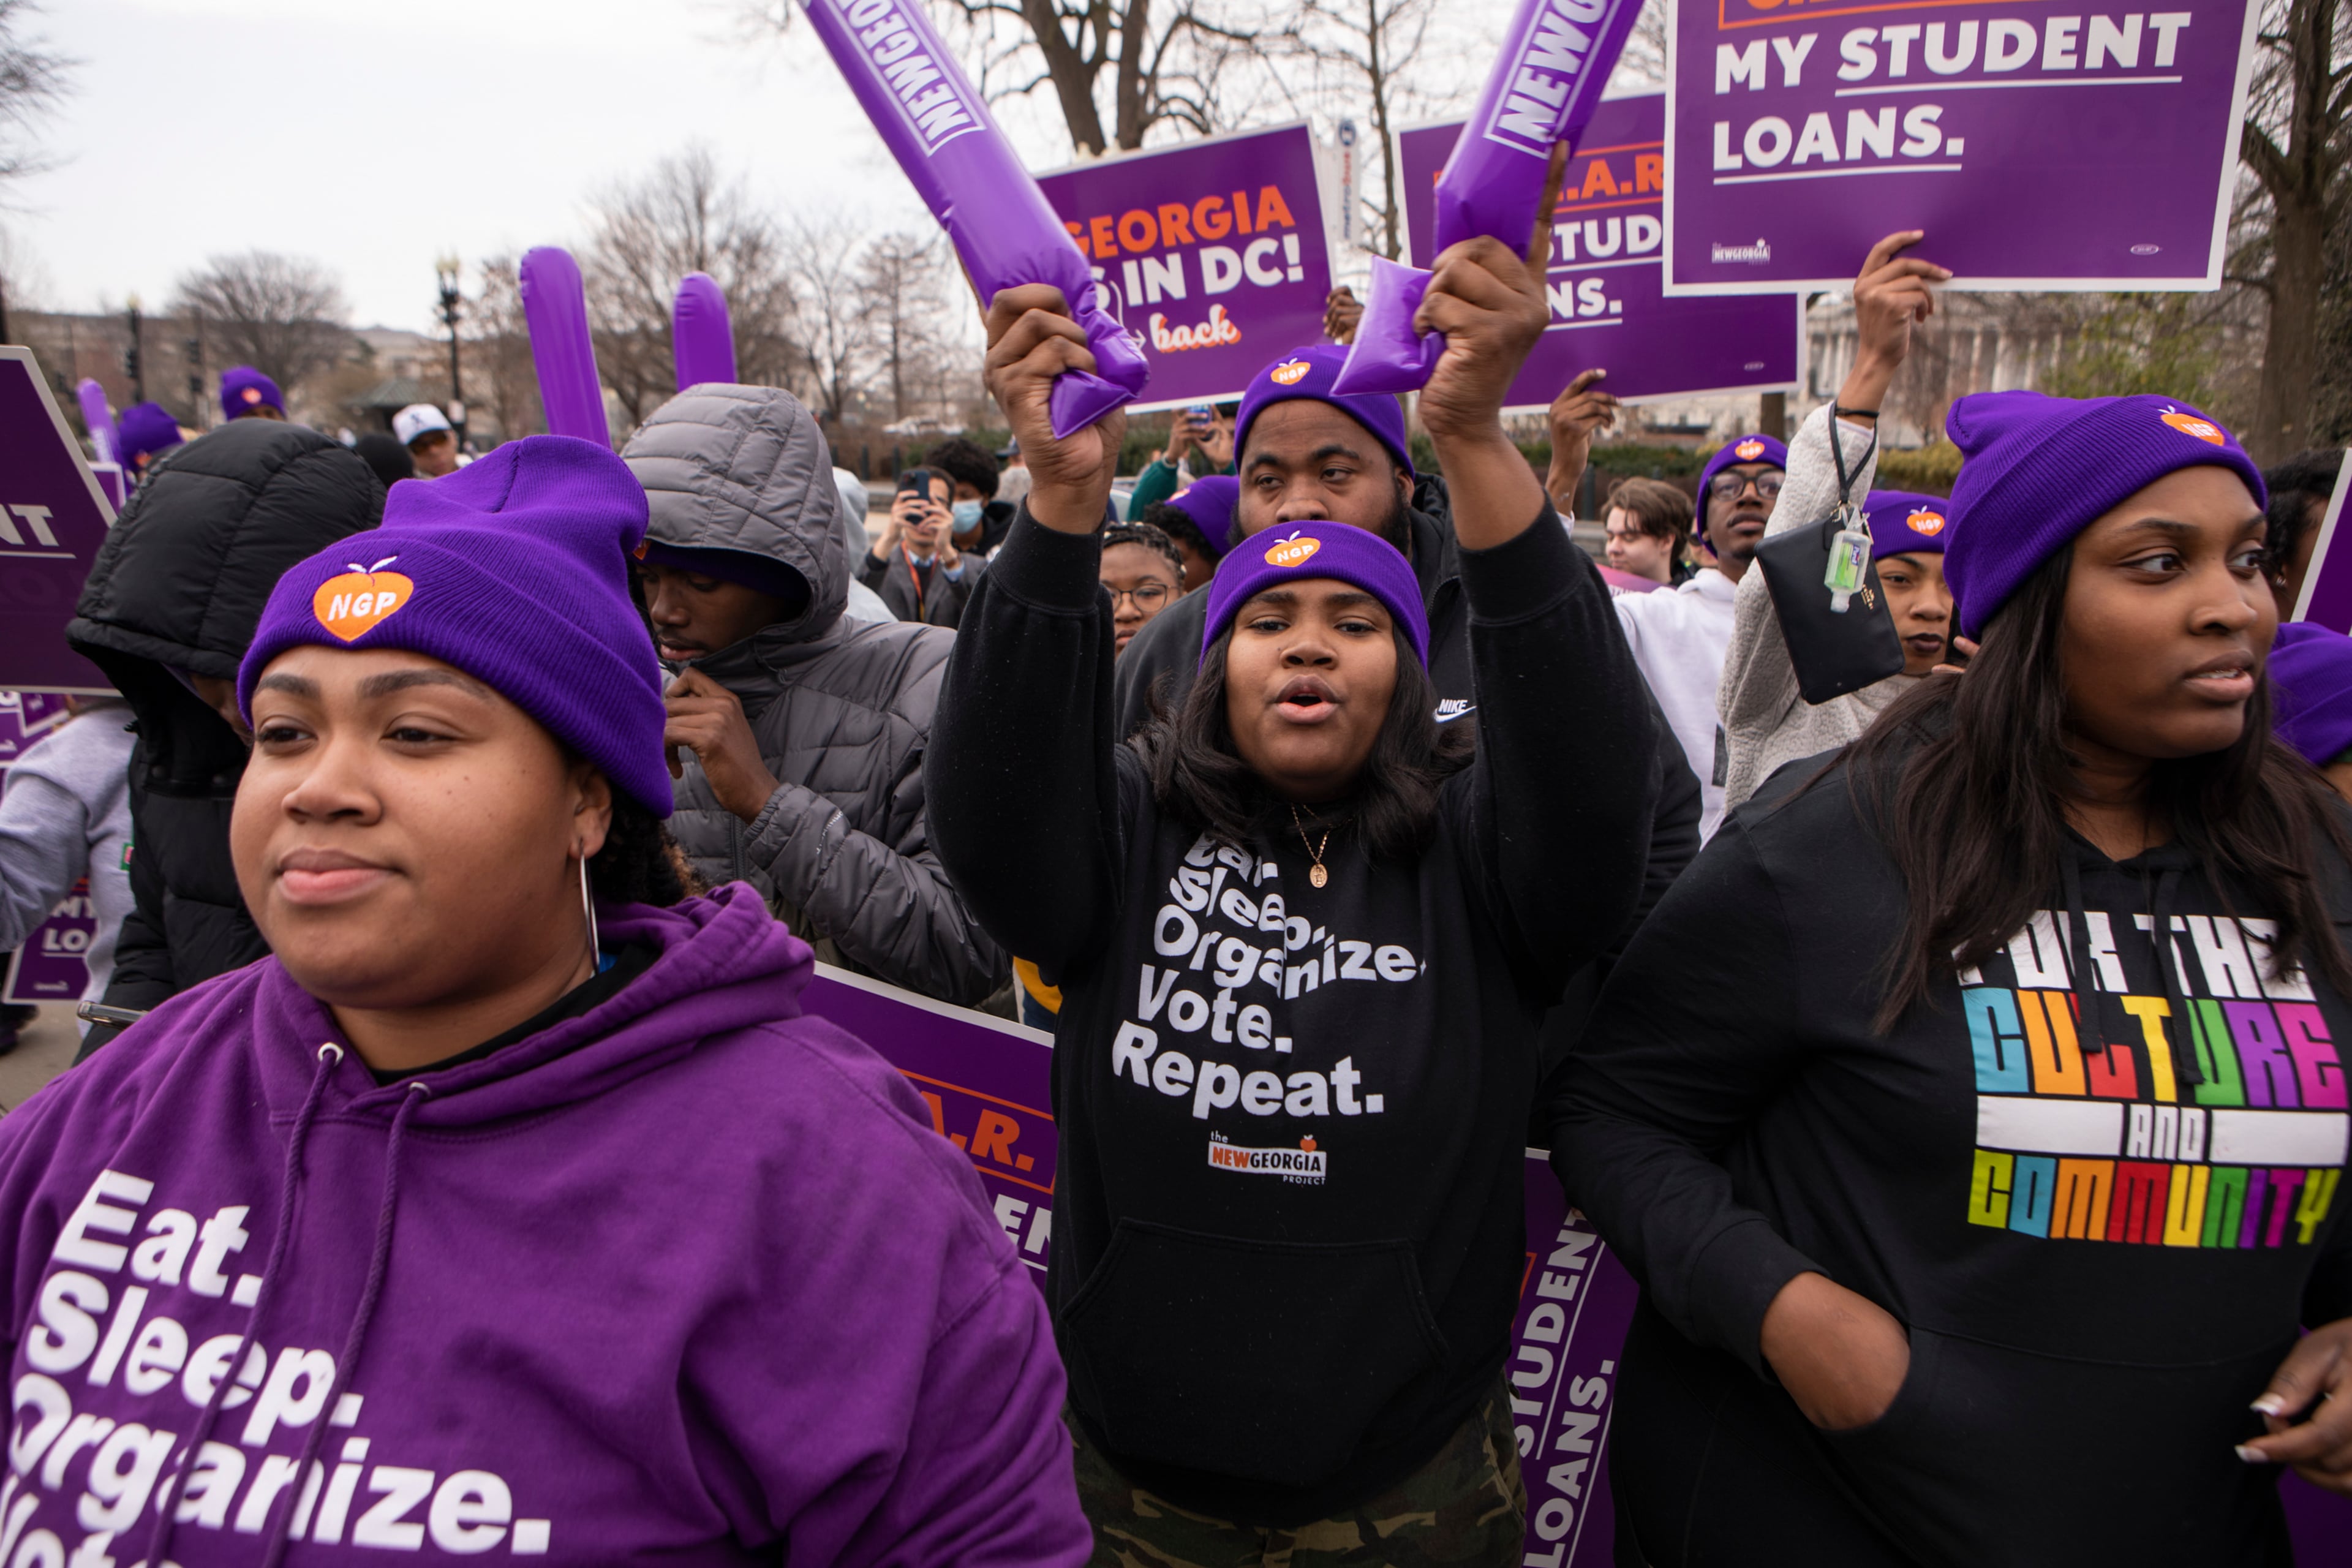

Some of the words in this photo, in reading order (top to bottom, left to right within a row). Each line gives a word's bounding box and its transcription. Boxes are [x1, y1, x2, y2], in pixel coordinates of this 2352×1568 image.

[1715, 33, 1819, 94] MY
[1836, 11, 2192, 81] STUDENT
[1714, 104, 1965, 170] LOANS.
[1122, 252, 1187, 307] IN
[1199, 233, 1304, 296] DC!
[1149, 303, 1242, 353] back
[1279, 366, 1306, 382] NGP
[1277, 545, 1314, 563] NGP
[327, 592, 397, 621] NGP
[1439, 698, 1468, 713] NIKE
[1138, 963, 1293, 1054] Vote.
[1112, 1020, 1384, 1120] Repeat.
[1961, 987, 2350, 1109] CULTURE
[1210, 1130, 1229, 1144] the
[2127, 1103, 2206, 1161] AND
[1283, 1175, 1326, 1185] PROJECT
[1967, 1148, 2342, 1248] COMMUNITY
[53, 1169, 263, 1308] Eat.
[26, 1270, 364, 1447] Sleep.
[9, 1373, 551, 1556] Organize.
